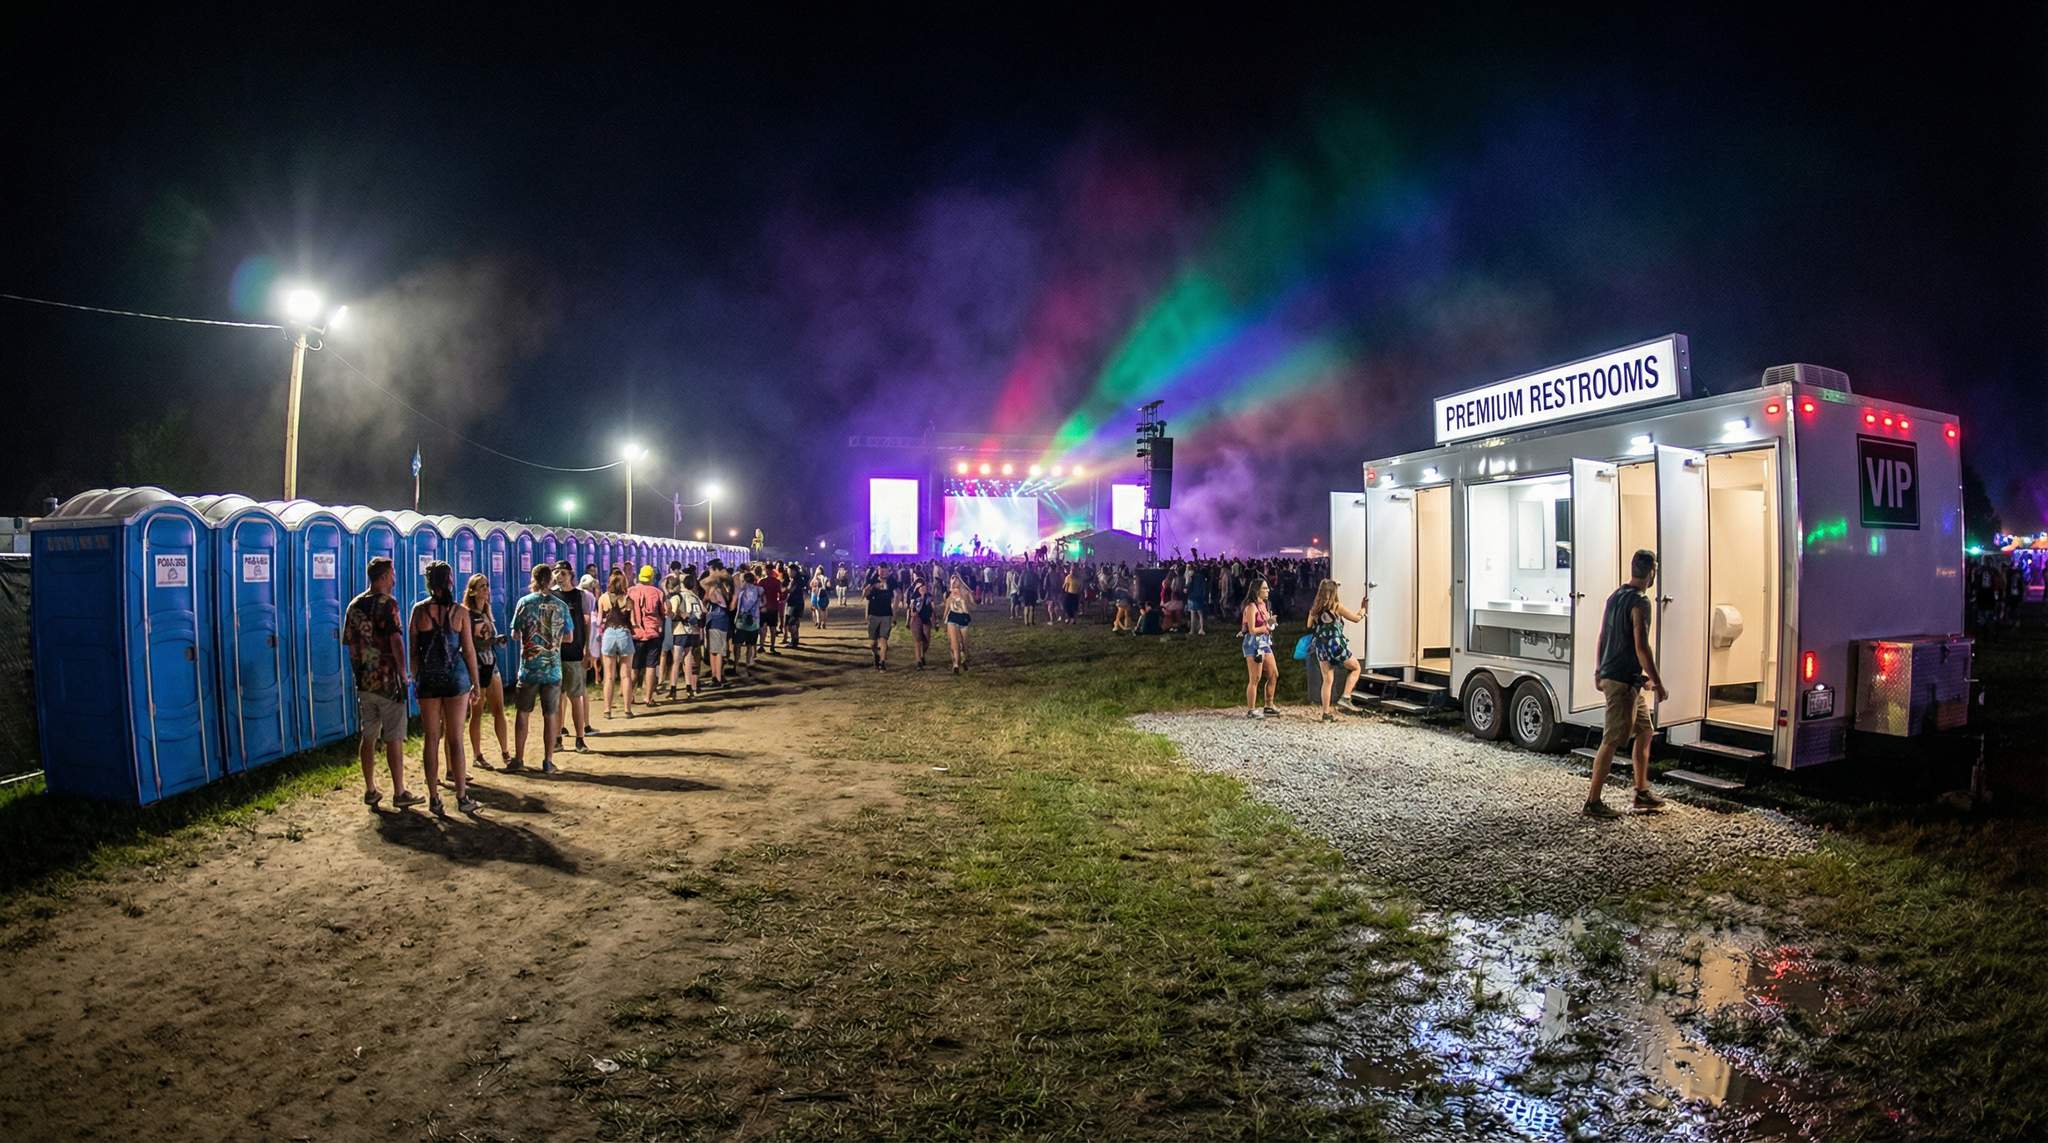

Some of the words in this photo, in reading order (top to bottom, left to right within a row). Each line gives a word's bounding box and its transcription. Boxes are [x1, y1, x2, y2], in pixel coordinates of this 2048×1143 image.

[1446, 388, 1523, 432] PREMIUM
[1530, 355, 1659, 413] RESTROOMS
[1866, 457, 1912, 508] VIP
